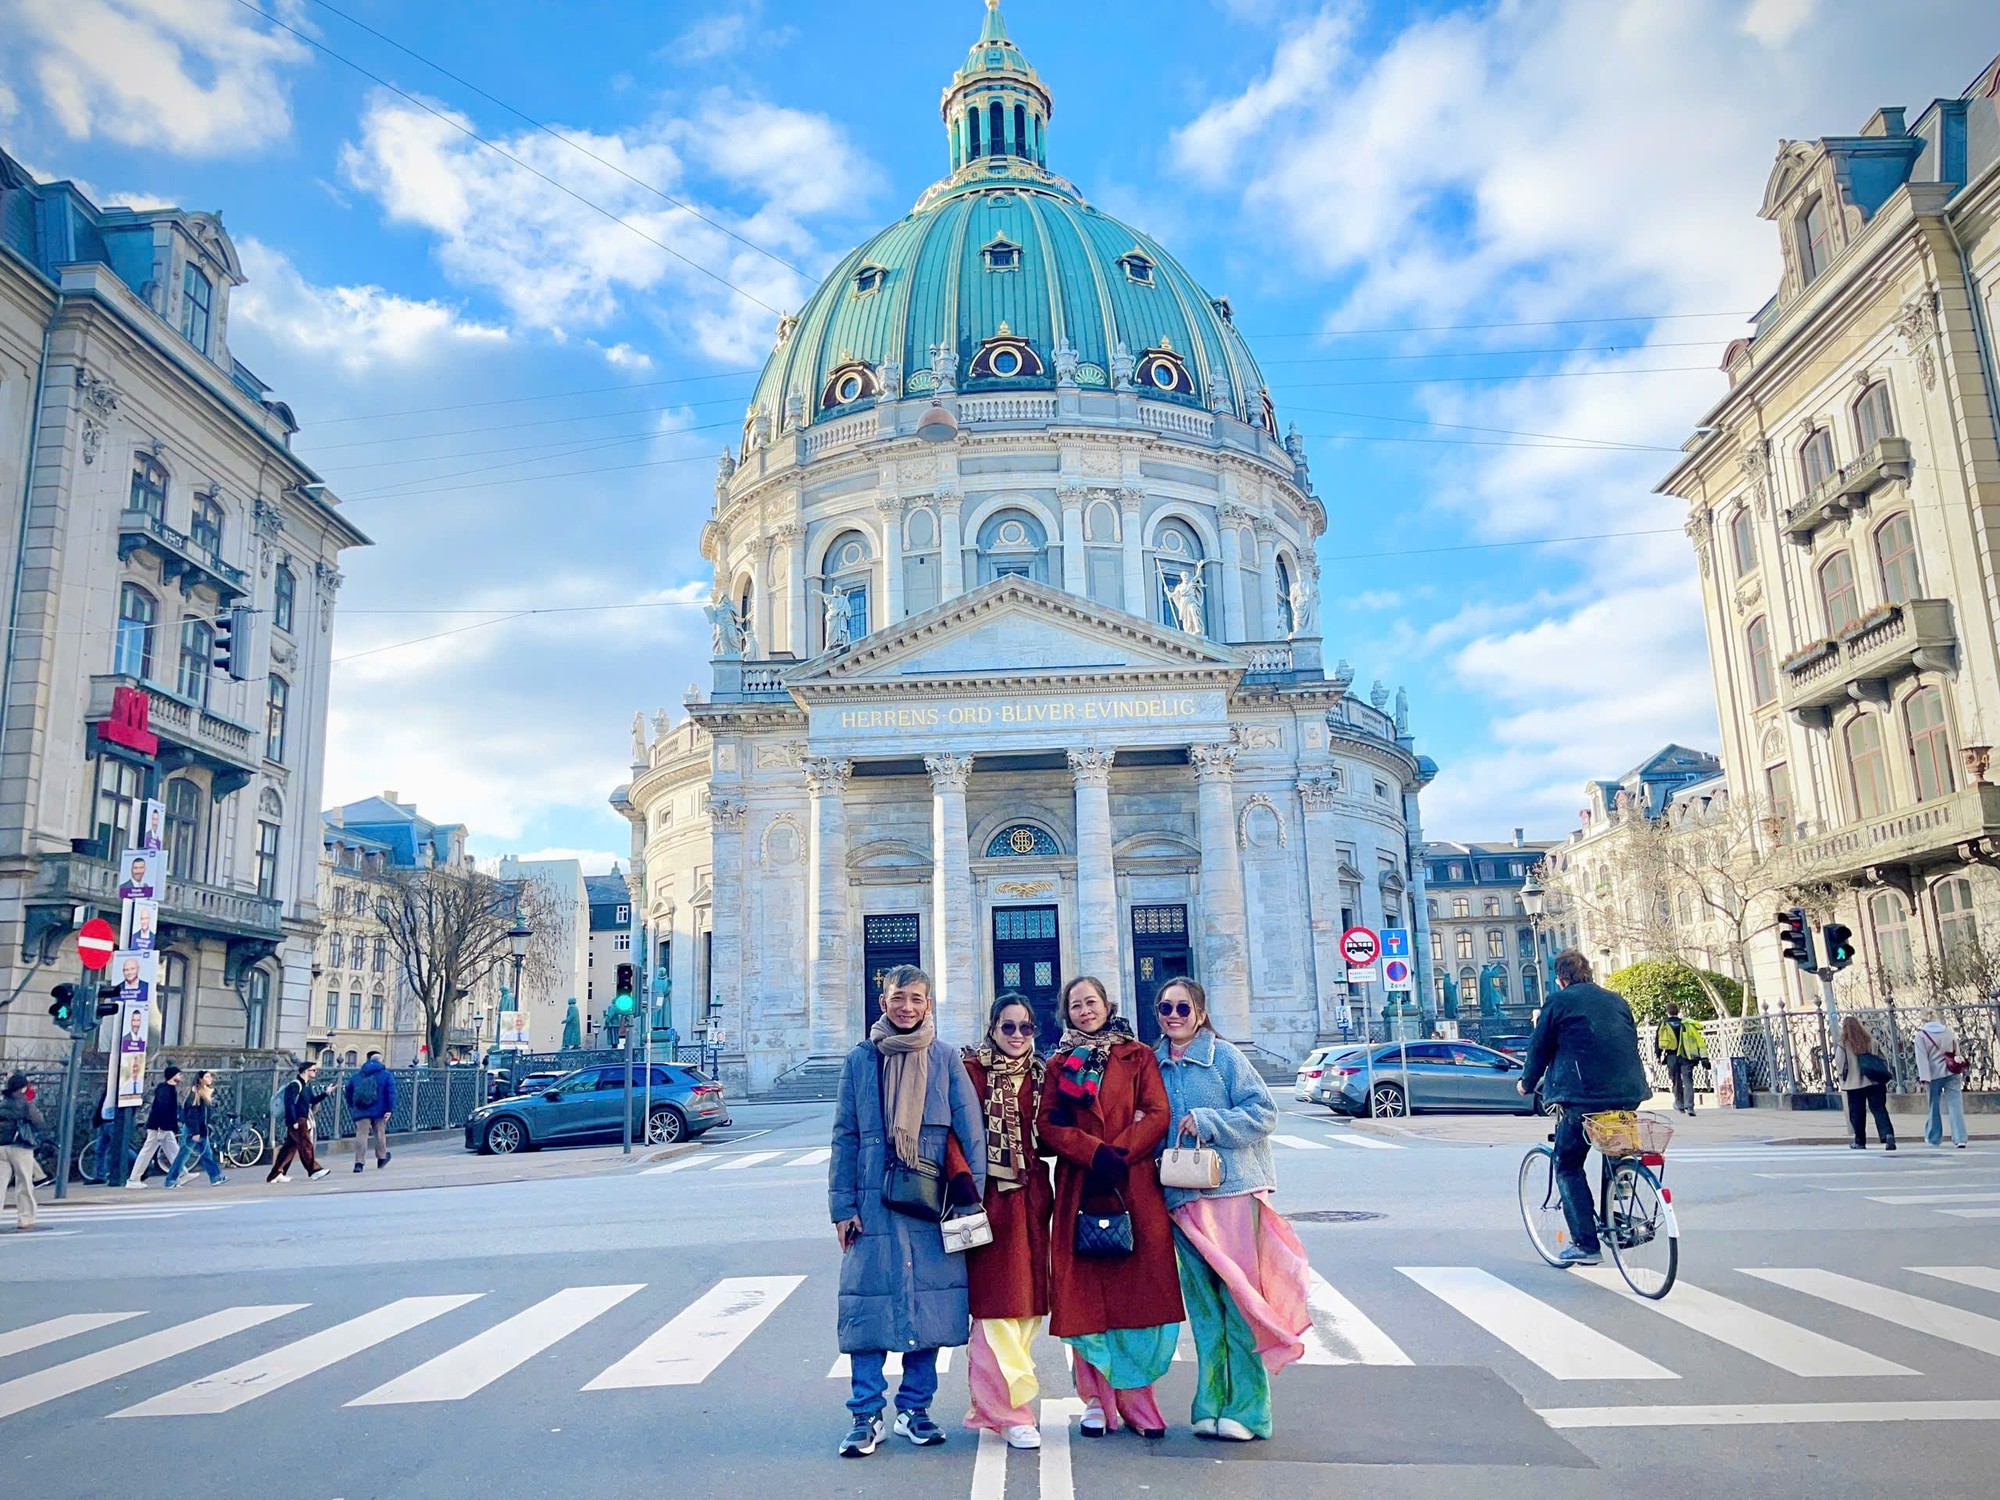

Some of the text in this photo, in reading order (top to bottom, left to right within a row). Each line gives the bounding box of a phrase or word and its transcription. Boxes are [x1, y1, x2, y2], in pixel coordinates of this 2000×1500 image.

[841, 699, 1196, 729] HERRENS ORD BLIVER EVINDELIG
